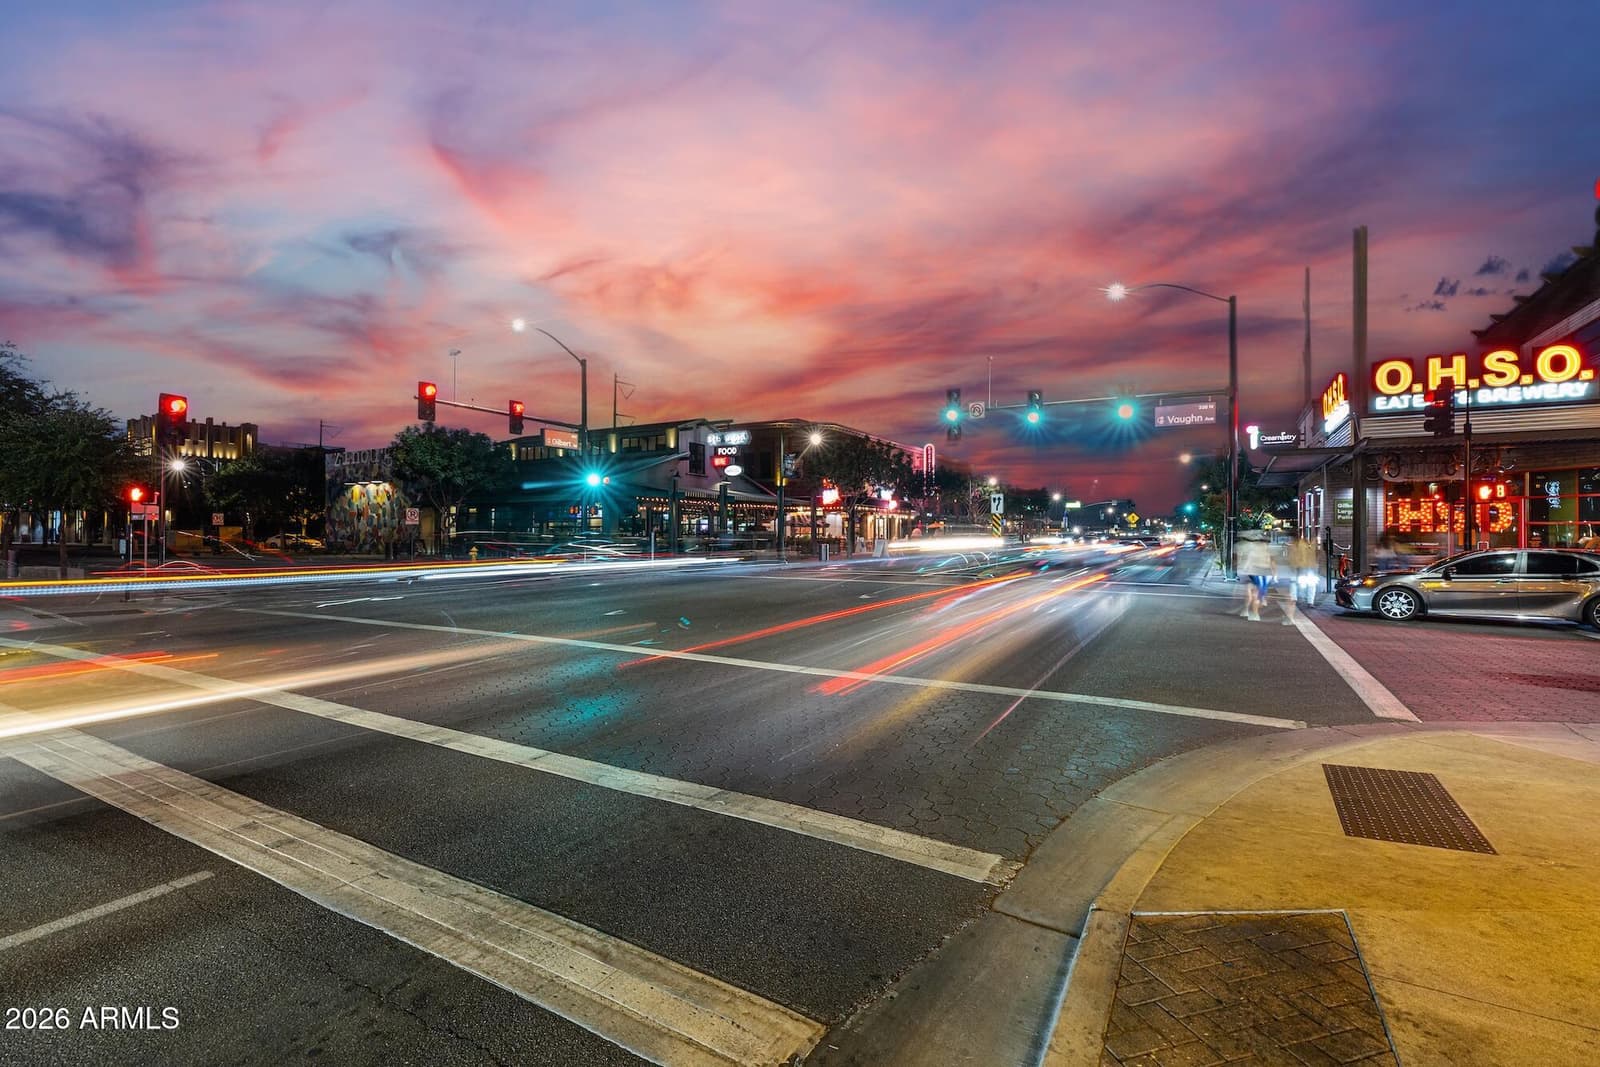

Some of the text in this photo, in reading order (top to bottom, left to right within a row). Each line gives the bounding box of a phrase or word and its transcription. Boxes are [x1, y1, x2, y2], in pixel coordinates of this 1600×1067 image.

[1375, 345, 1594, 395] O.H.S.O.
[1375, 393, 1431, 411] EATE
[1477, 382, 1590, 404] BREWERY
[1167, 413, 1203, 425] Vaughn
[718, 446, 738, 456] FOOD
